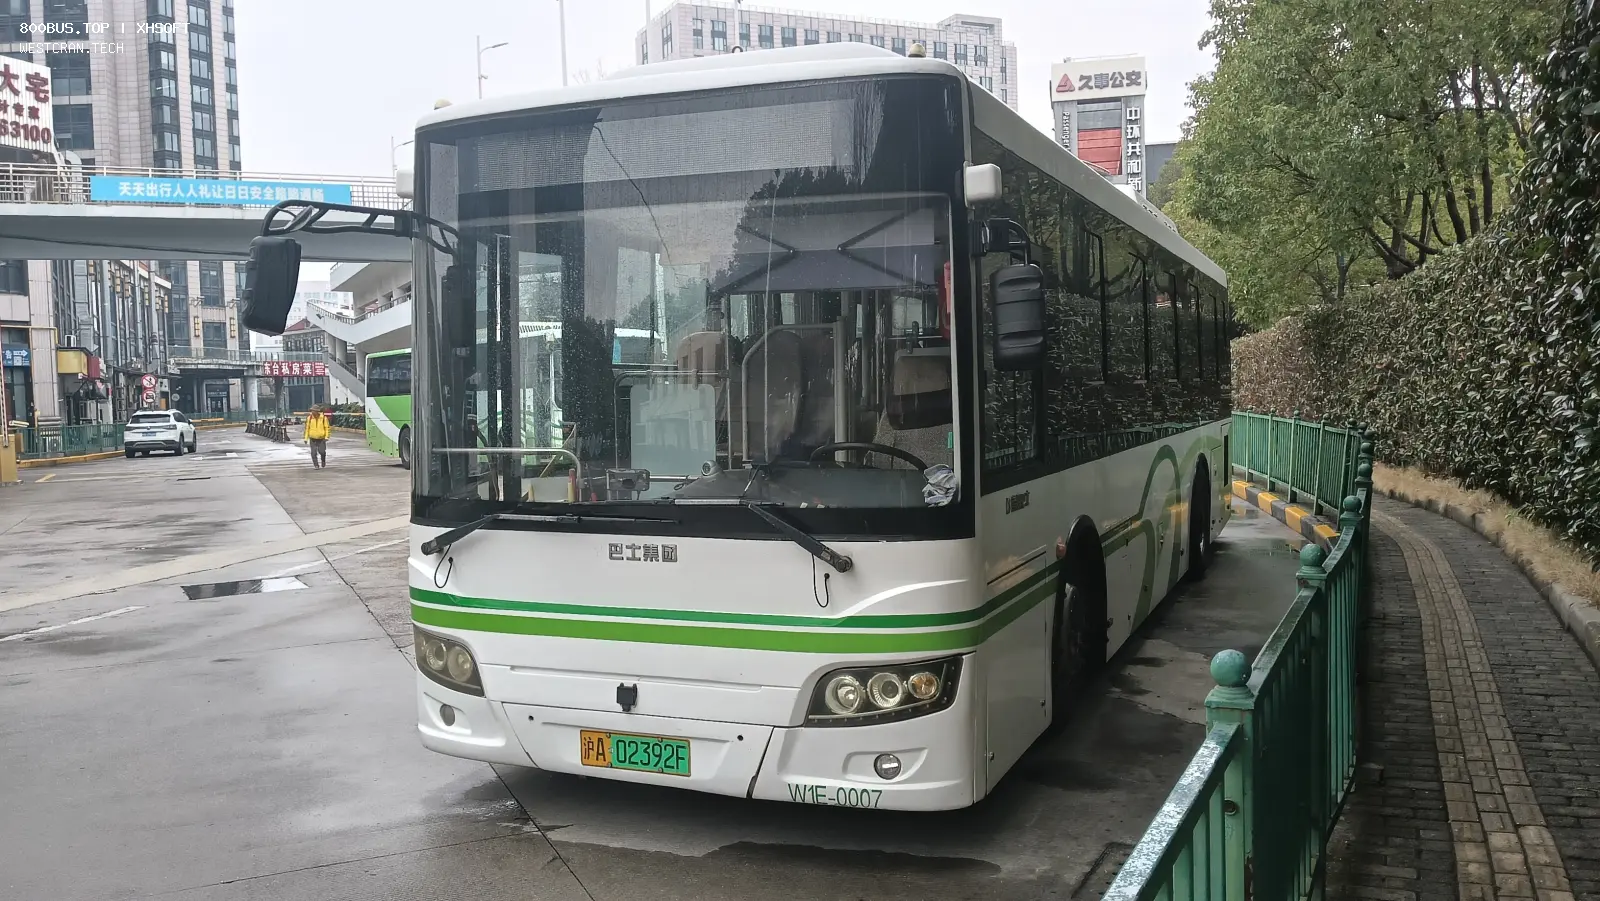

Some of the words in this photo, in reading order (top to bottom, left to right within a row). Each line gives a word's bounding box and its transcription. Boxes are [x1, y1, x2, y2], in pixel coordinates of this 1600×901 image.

[0, 63, 49, 103] 大宅
[1078, 70, 1142, 90] 久事公交
[608, 542, 678, 562] 巴士集团
[583, 737, 607, 762] 沪A
[615, 739, 688, 770] 02392F
[787, 783, 883, 809] W1E-0007
